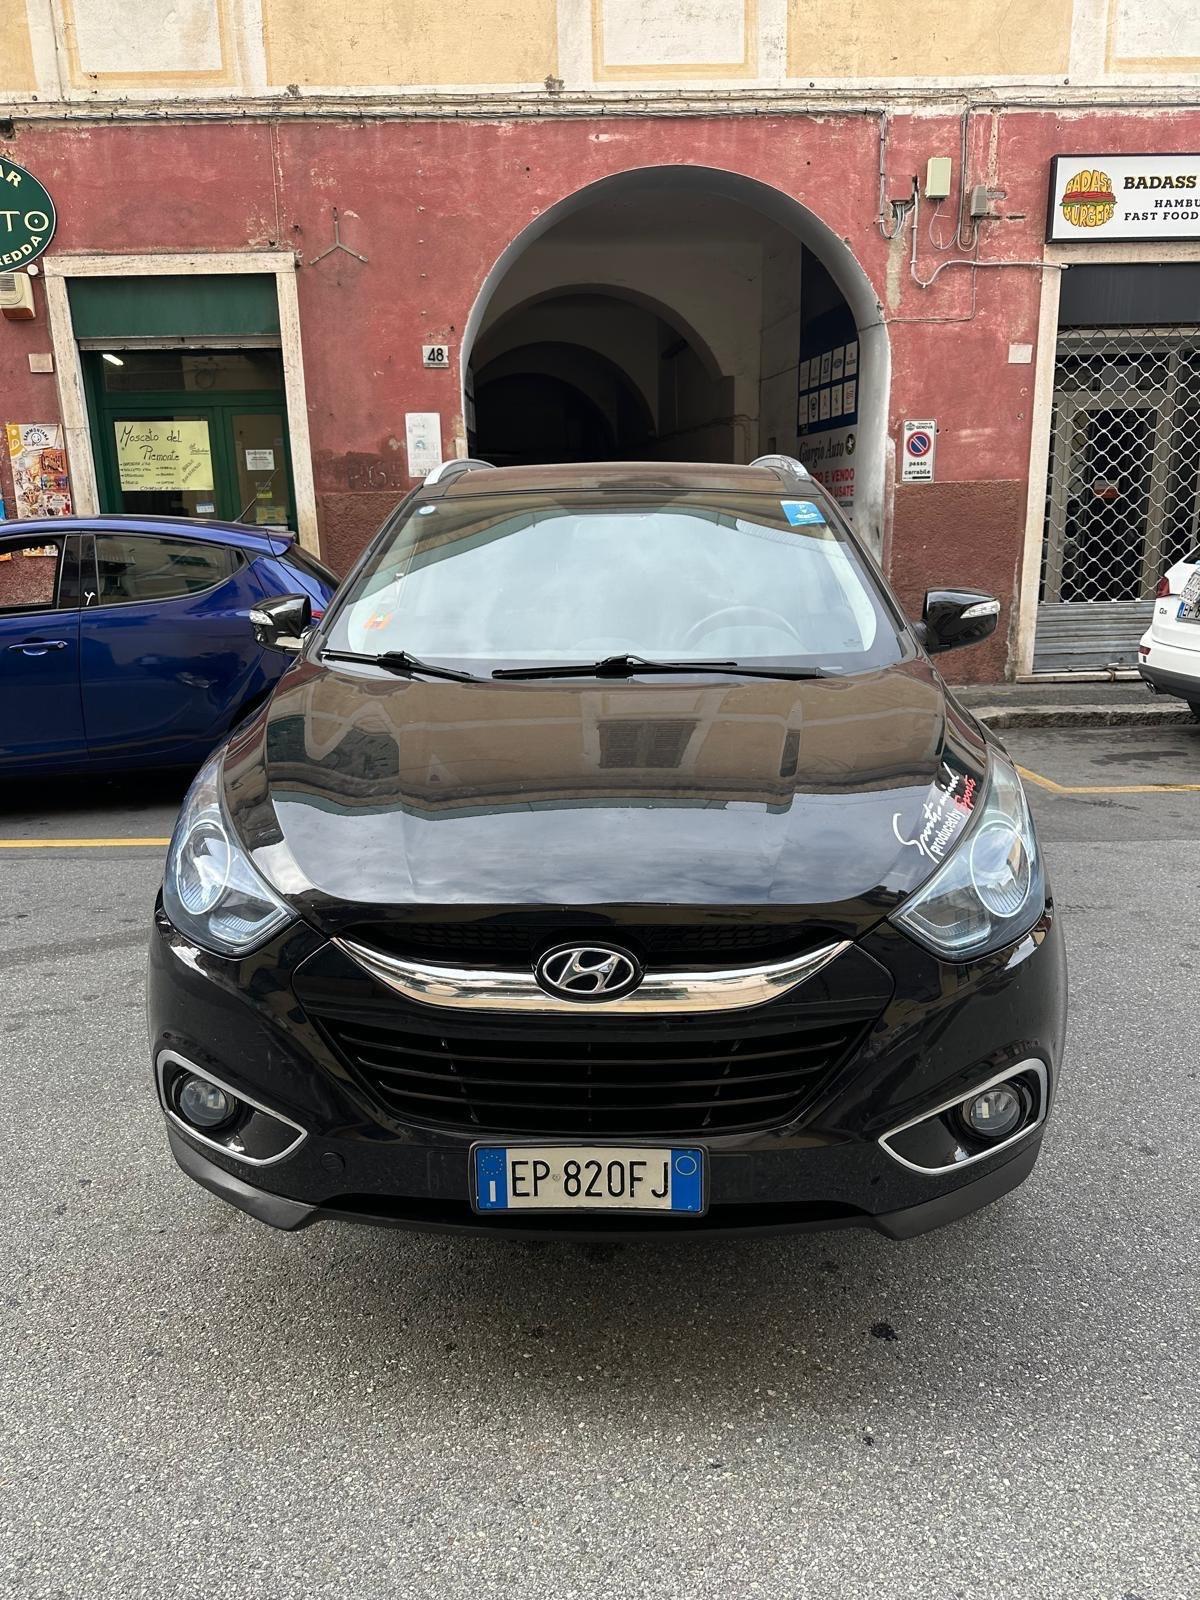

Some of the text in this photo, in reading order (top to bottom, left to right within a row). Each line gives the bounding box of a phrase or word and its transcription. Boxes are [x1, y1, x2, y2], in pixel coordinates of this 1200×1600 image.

[1123, 175, 1197, 190] BADASS
[1124, 211, 1199, 221] FAST FOOD
[428, 347, 444, 362] 48
[120, 425, 182, 447] Moscato del
[139, 445, 180, 461] Piemonte
[825, 437, 844, 459] Auto
[832, 468, 854, 482] VENDO
[835, 484, 855, 497] USATE
[511, 1160, 551, 1197] EP
[563, 1160, 669, 1198] 820FJ
